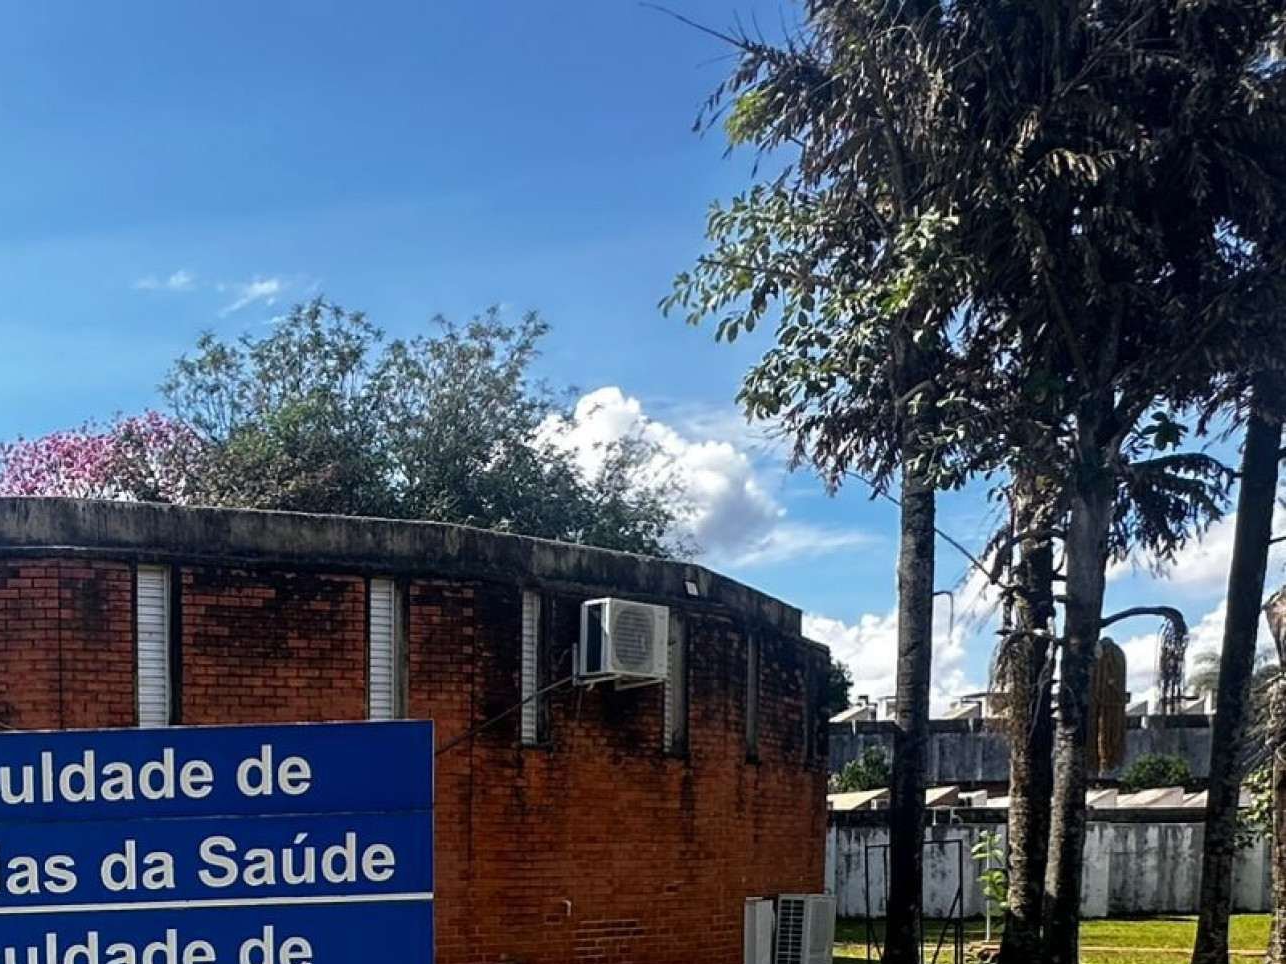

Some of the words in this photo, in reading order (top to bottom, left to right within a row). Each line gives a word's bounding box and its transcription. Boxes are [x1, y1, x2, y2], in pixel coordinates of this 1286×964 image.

[237, 744, 311, 797] de
[100, 840, 176, 891] da
[198, 832, 395, 888] Saúde
